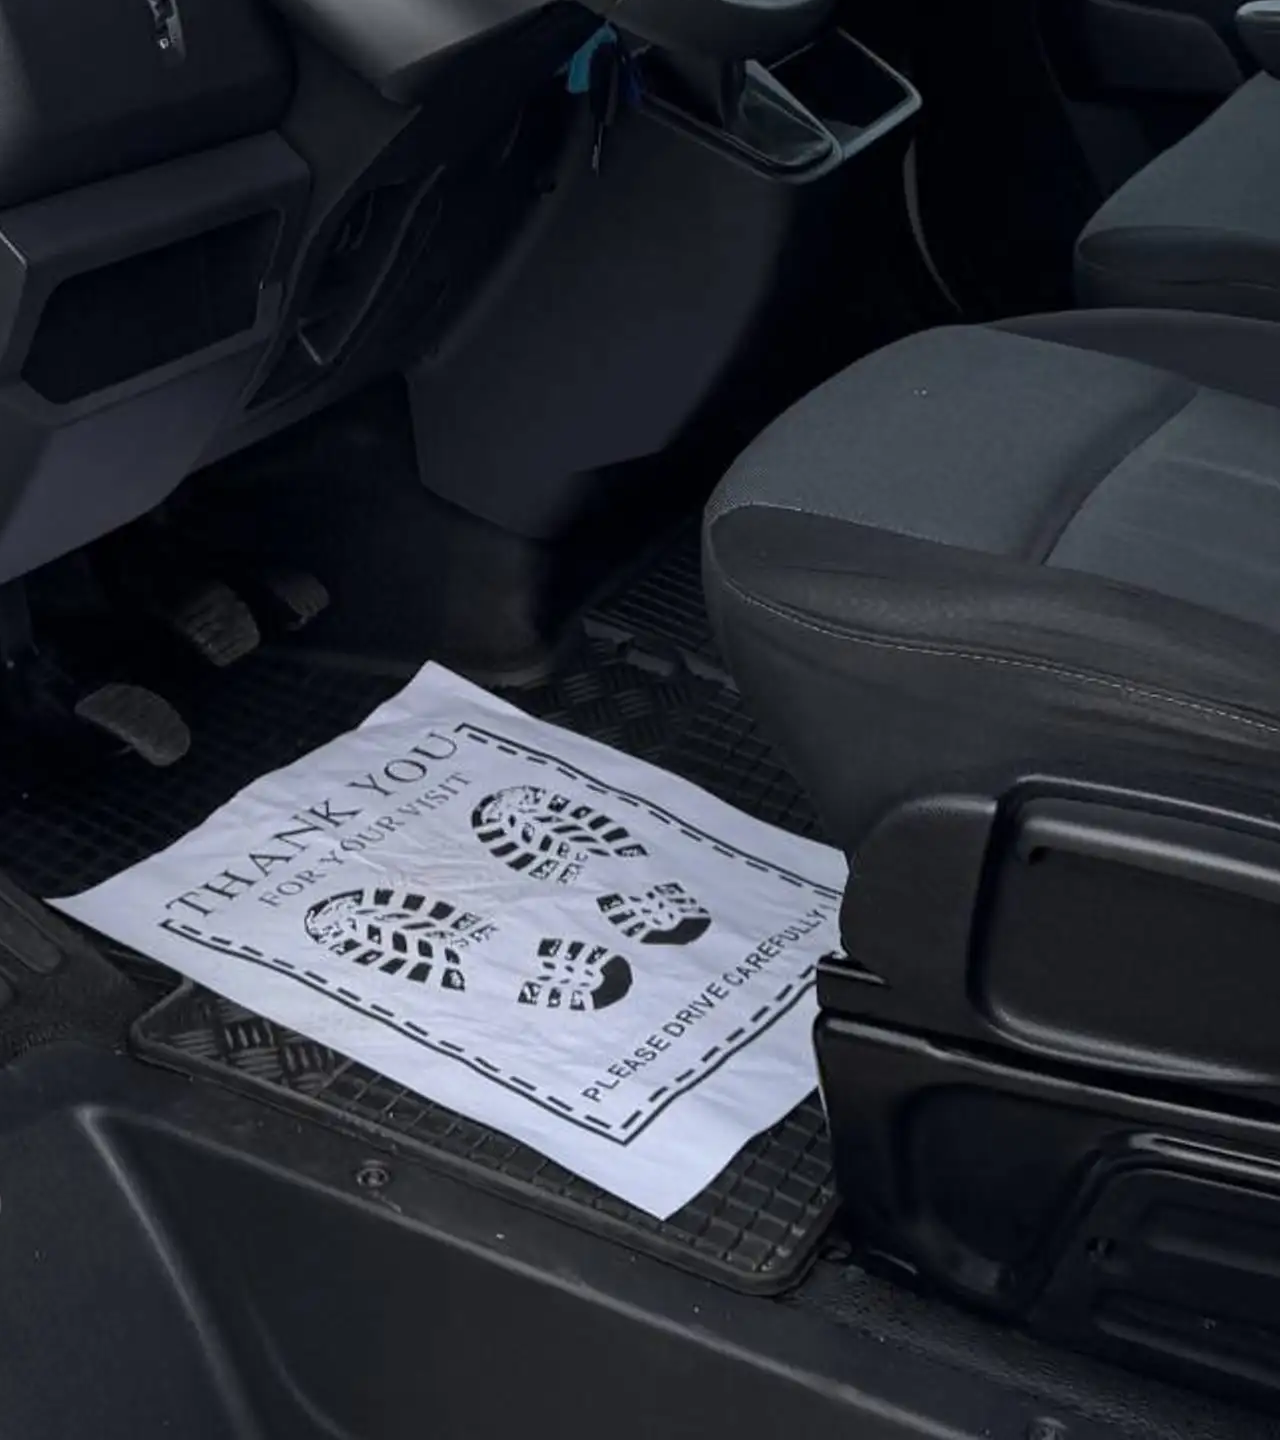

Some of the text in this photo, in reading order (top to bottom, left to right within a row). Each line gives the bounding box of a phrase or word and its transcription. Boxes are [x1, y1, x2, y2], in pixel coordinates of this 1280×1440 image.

[165, 731, 458, 917] THANK YOU
[259, 770, 472, 908] FOR YOUR VISIT
[581, 1034, 672, 1103] PLEASE
[662, 981, 730, 1039] DRIVE
